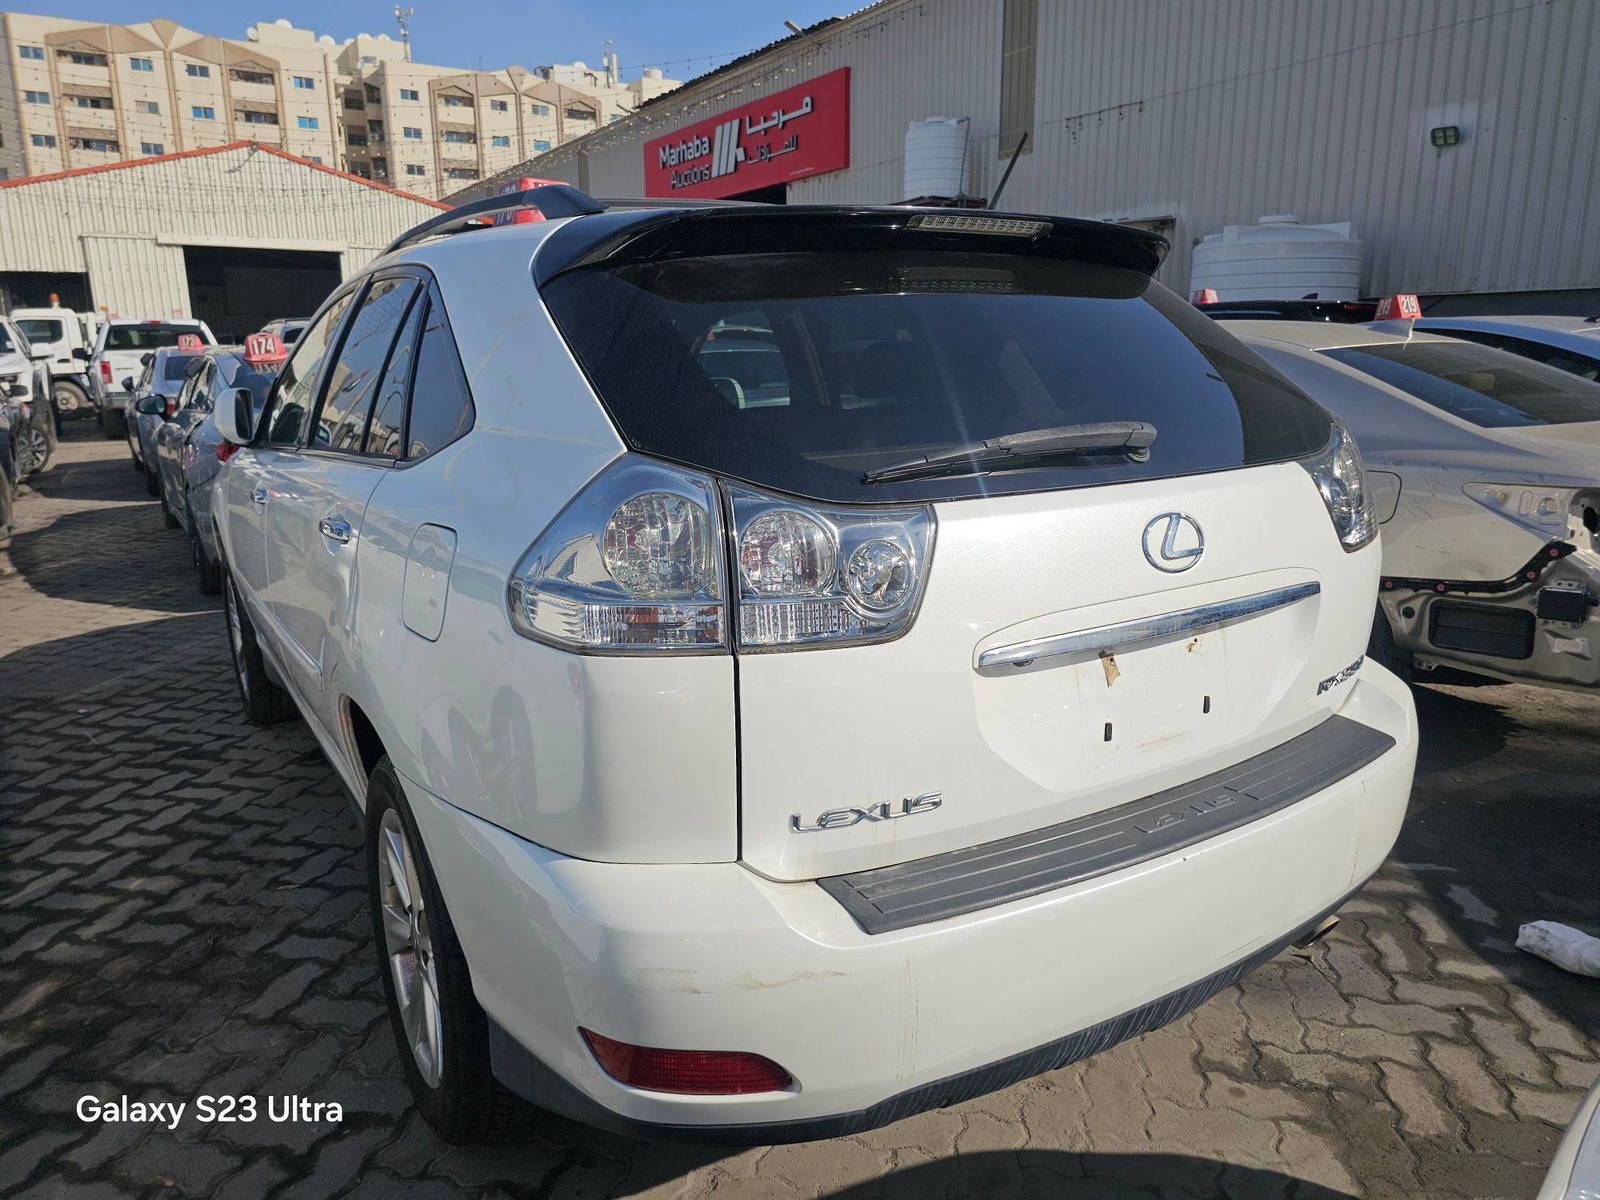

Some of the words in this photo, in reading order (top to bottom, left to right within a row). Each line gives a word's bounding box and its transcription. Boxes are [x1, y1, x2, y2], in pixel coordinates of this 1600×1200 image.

[746, 96, 813, 135] مرحبا
[658, 134, 710, 170] Marhaba
[671, 165, 712, 189] Auctions
[182, 335, 196, 347] 173
[251, 337, 276, 355] 174
[790, 790, 943, 834] LEXUS
[1133, 794, 1239, 834] LEXUS
